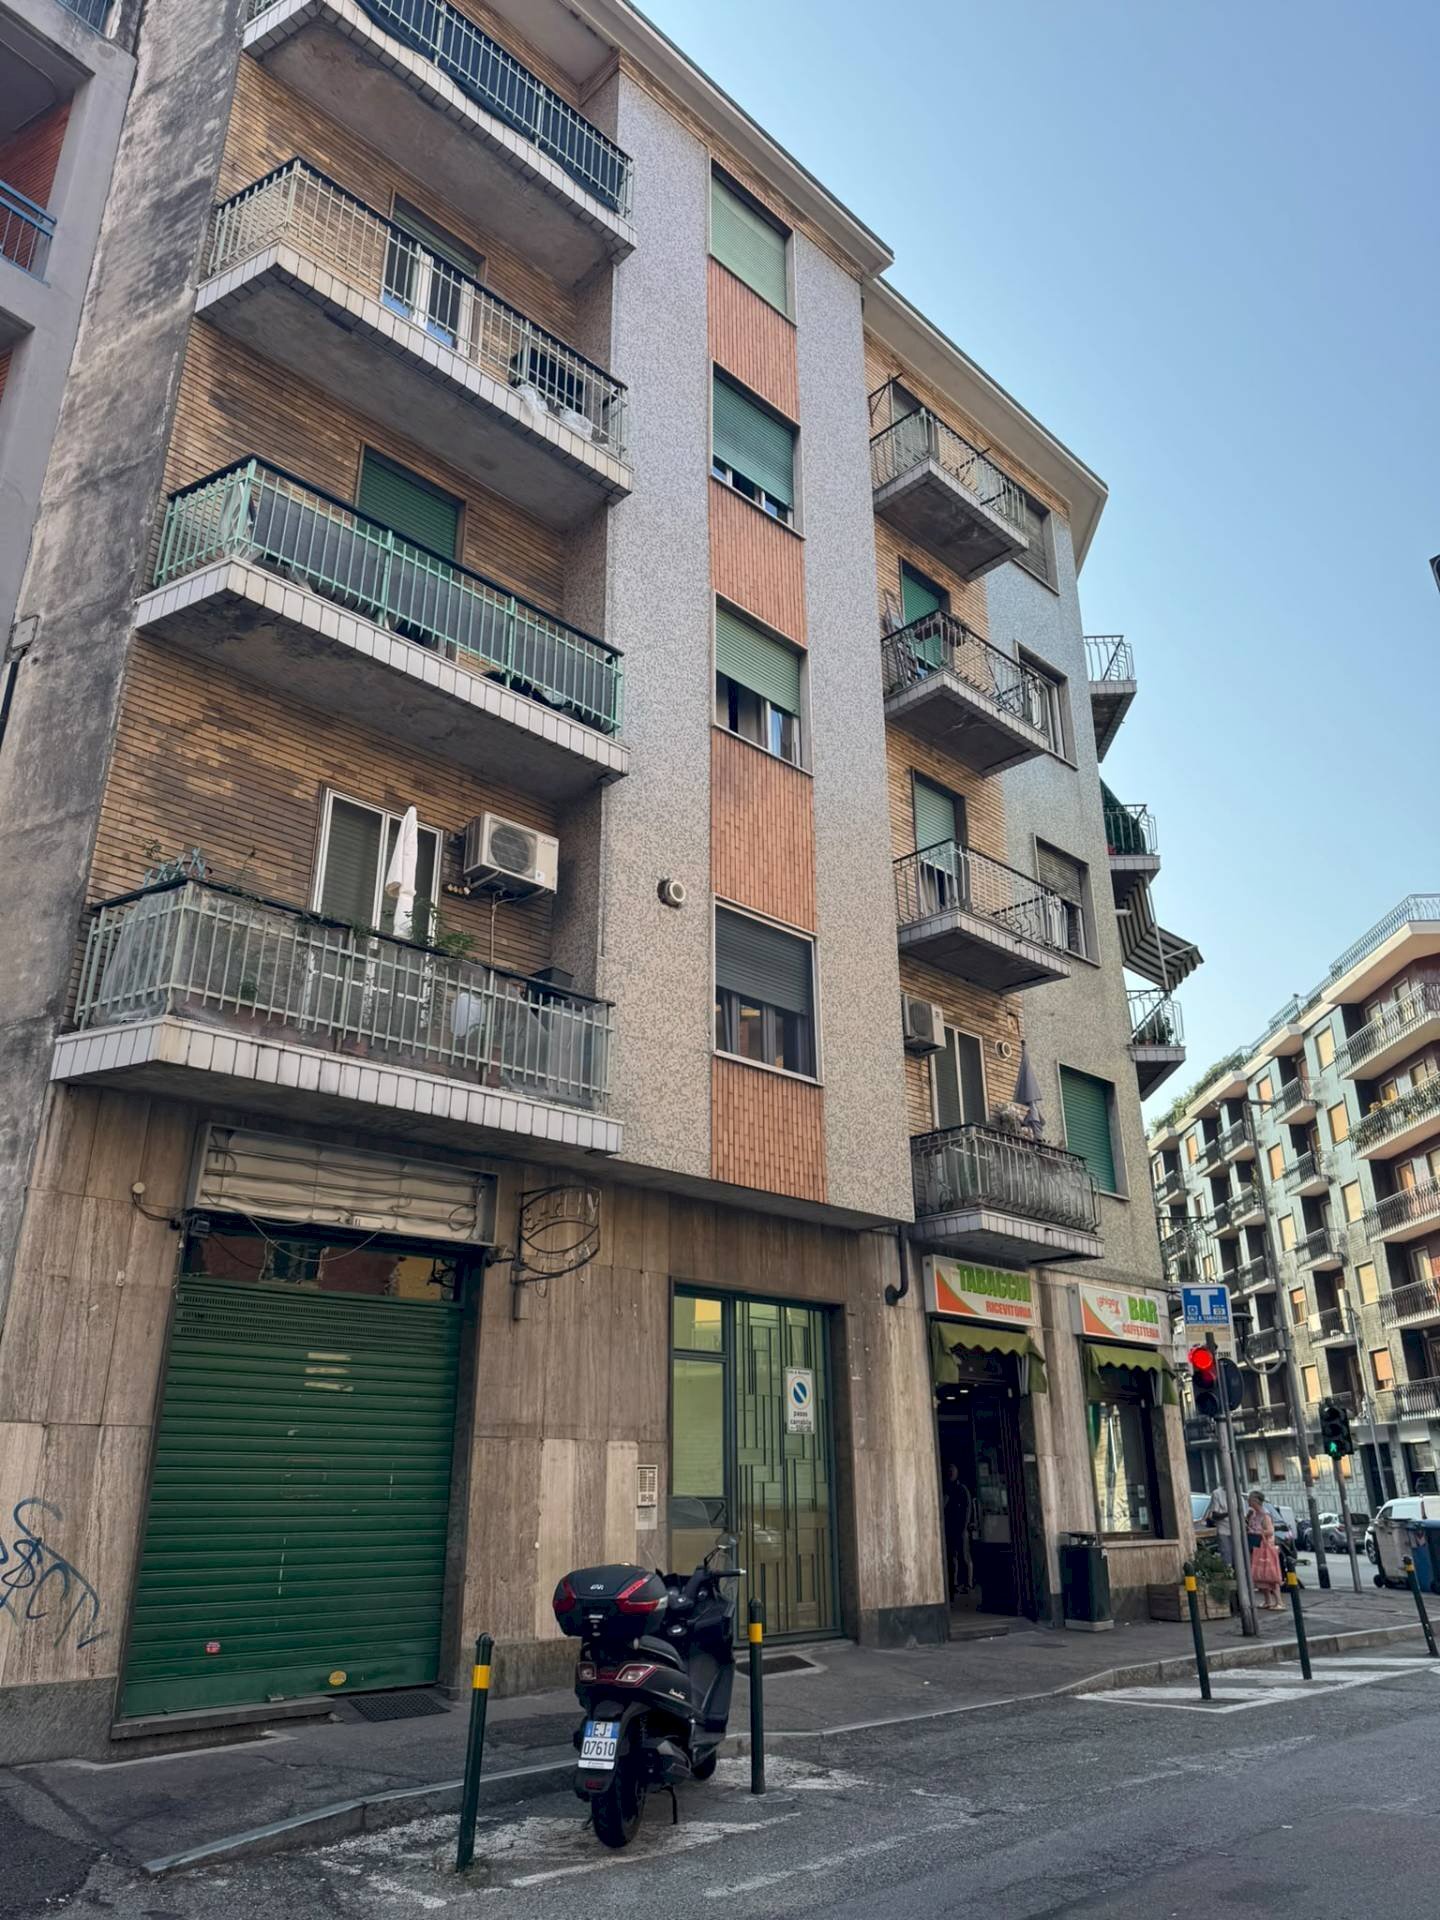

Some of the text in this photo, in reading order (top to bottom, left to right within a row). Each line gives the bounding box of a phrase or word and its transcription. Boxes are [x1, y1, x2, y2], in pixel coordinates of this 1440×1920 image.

[956, 1264, 1031, 1302] TABACCHI
[985, 1300, 1032, 1318] RICEVITORIA
[1127, 1295, 1159, 1325] BAR
[1190, 1289, 1218, 1316] T
[1122, 1323, 1159, 1338] CAFFETTERIA
[593, 1722, 608, 1737] EJ
[583, 1740, 616, 1757] 07610
